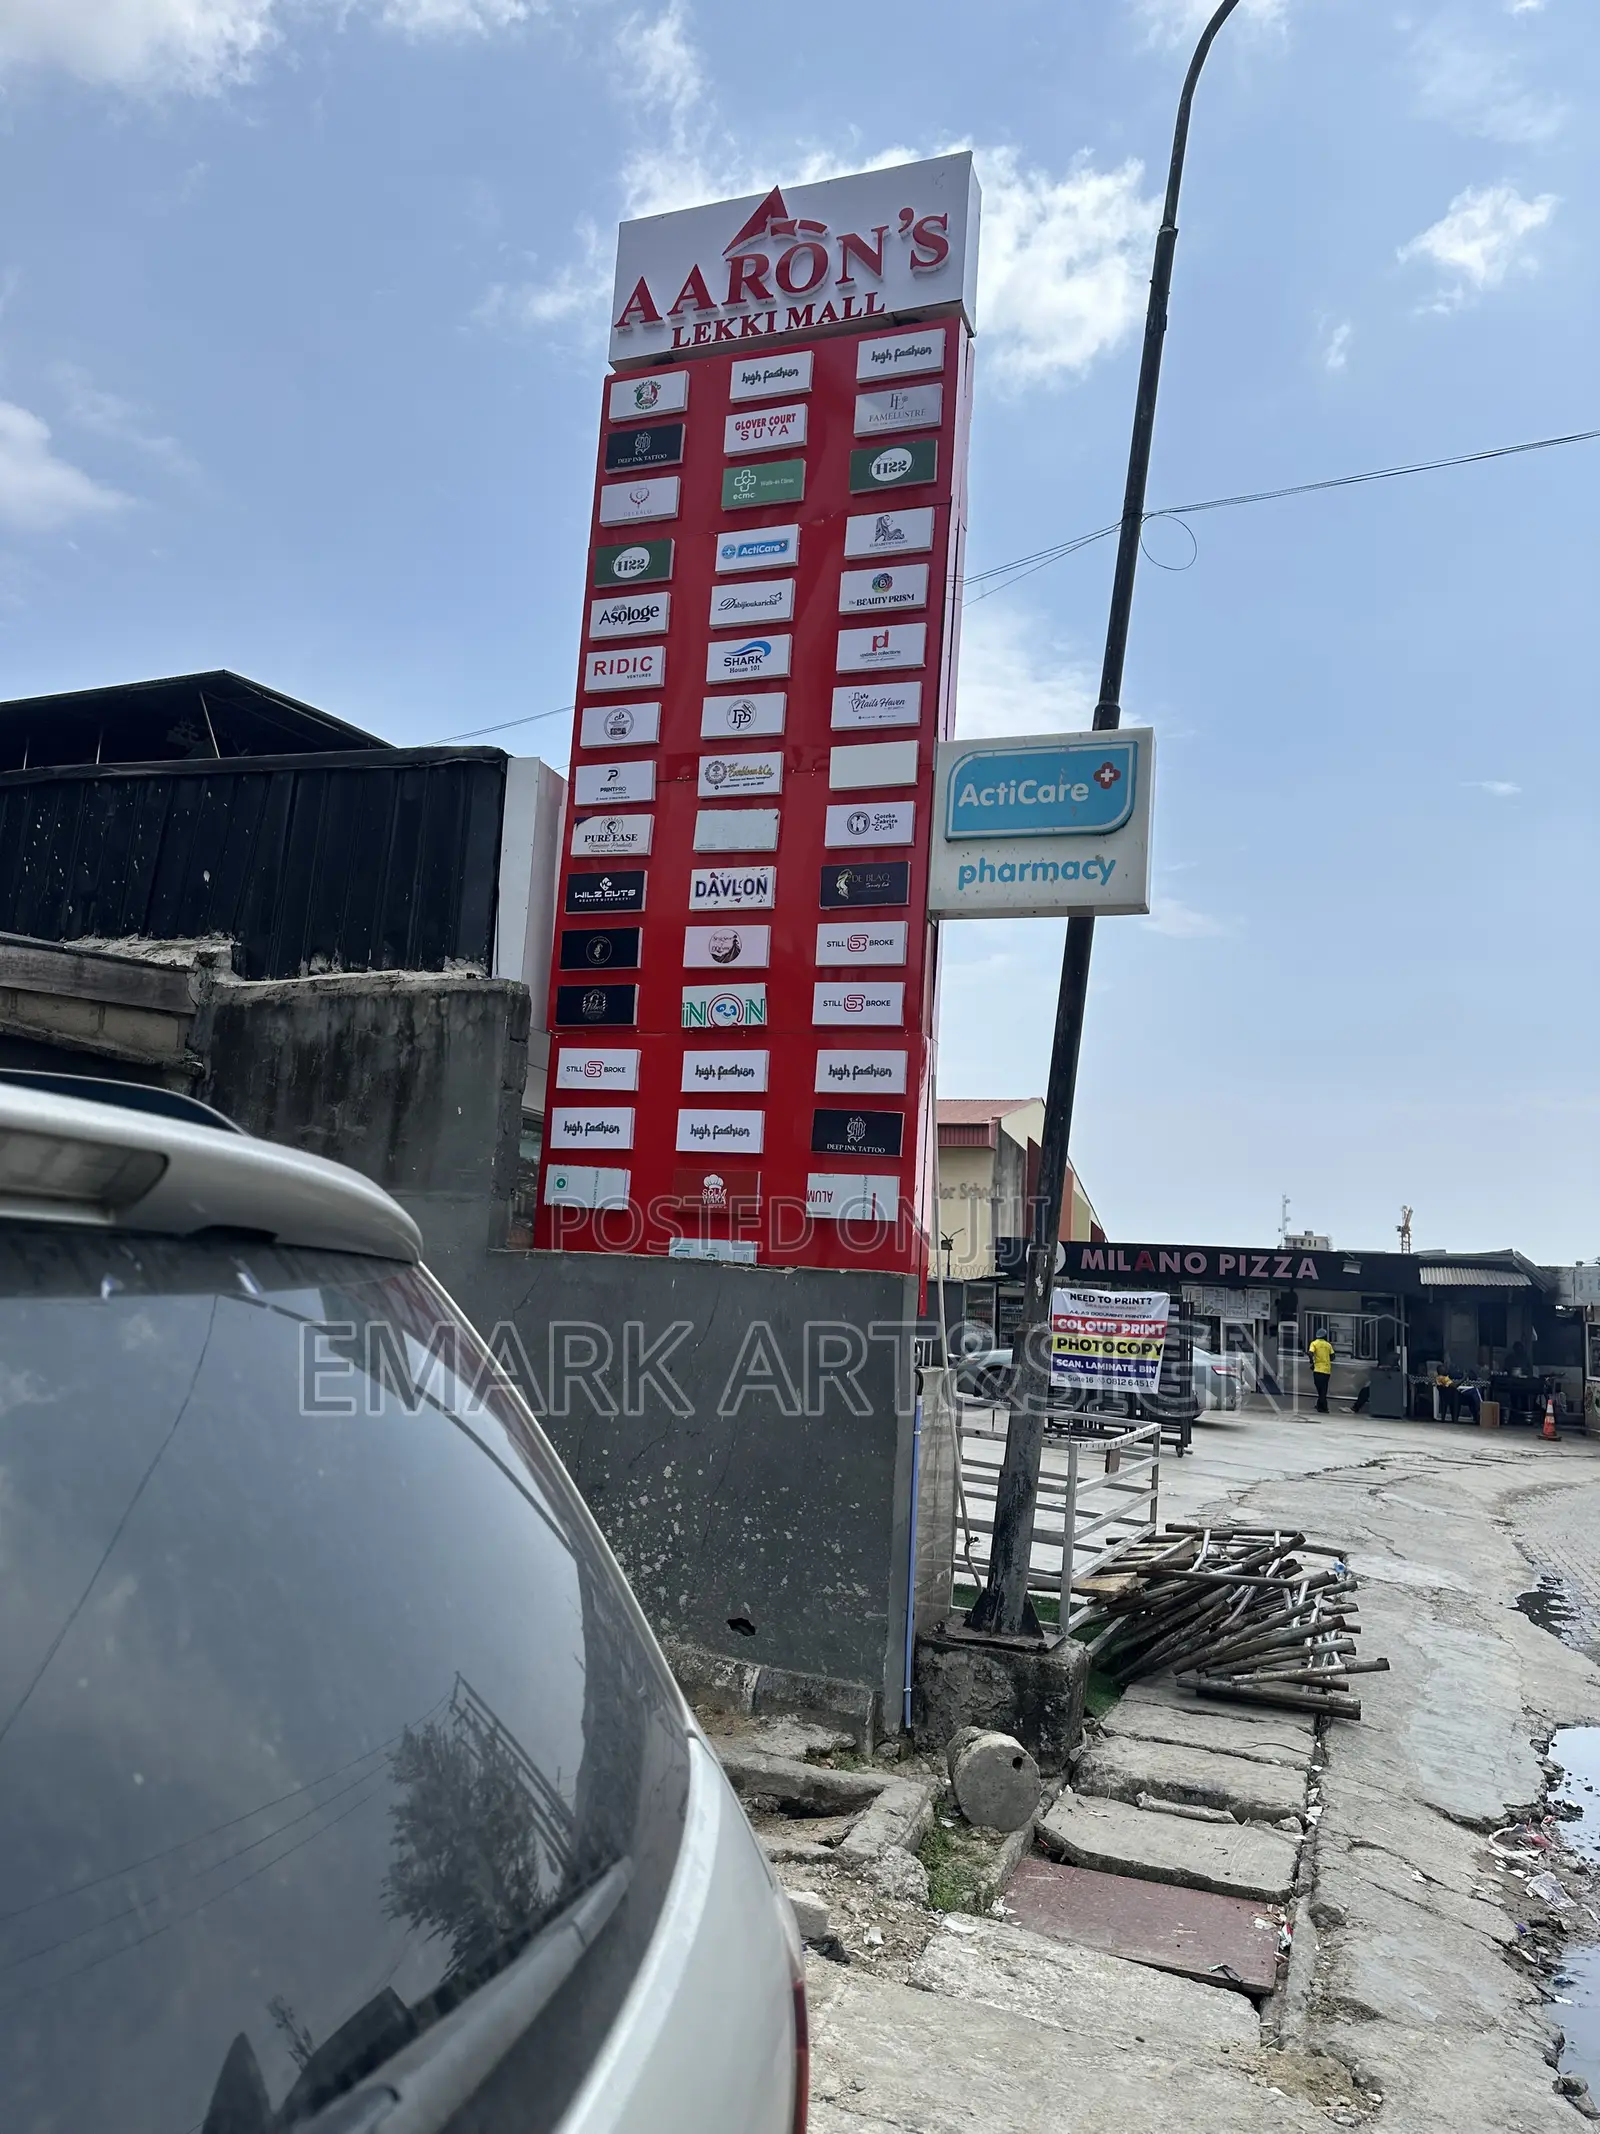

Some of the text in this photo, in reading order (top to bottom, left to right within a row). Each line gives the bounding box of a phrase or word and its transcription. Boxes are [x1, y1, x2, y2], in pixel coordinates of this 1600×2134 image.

[614, 207, 949, 330] AARON'S
[671, 292, 886, 349] LEKKI MALL
[871, 345, 932, 364] high fashion
[741, 367, 799, 385] high fashion
[735, 413, 796, 431] GLOVER COURT
[740, 424, 789, 441] SUYA
[733, 492, 755, 500] ecmc
[740, 545, 780, 555] ActiCare
[856, 597, 888, 606] BEAUTY
[888, 594, 915, 603] PRISM
[594, 656, 653, 676] RIDIC
[723, 655, 763, 667] SHARK
[855, 699, 879, 709] Nails
[880, 698, 905, 707] Haven
[958, 779, 1089, 808] ActiCare
[584, 833, 638, 843] PURE EASE
[958, 857, 1116, 891] pharmacy
[574, 889, 636, 899] WILZ CUTS
[695, 1064, 755, 1080] high fashion
[828, 1064, 893, 1080] high fashion
[563, 1121, 620, 1137] high fashion
[690, 1124, 751, 1140] high fashion
[858, 1146, 886, 1154] TATTOO
[1080, 1248, 1319, 1280] MILANO PIZZA
[1070, 1293, 1152, 1305] NEED TO PRINT?
[1057, 1318, 1165, 1335] COLOUR PRINT
[1057, 1337, 1163, 1356] PHOTOCOPY
[1056, 1359, 1084, 1368] SCAN.
[1085, 1361, 1137, 1373] LAMINATE.
[1107, 1378, 1126, 1386] 0812
